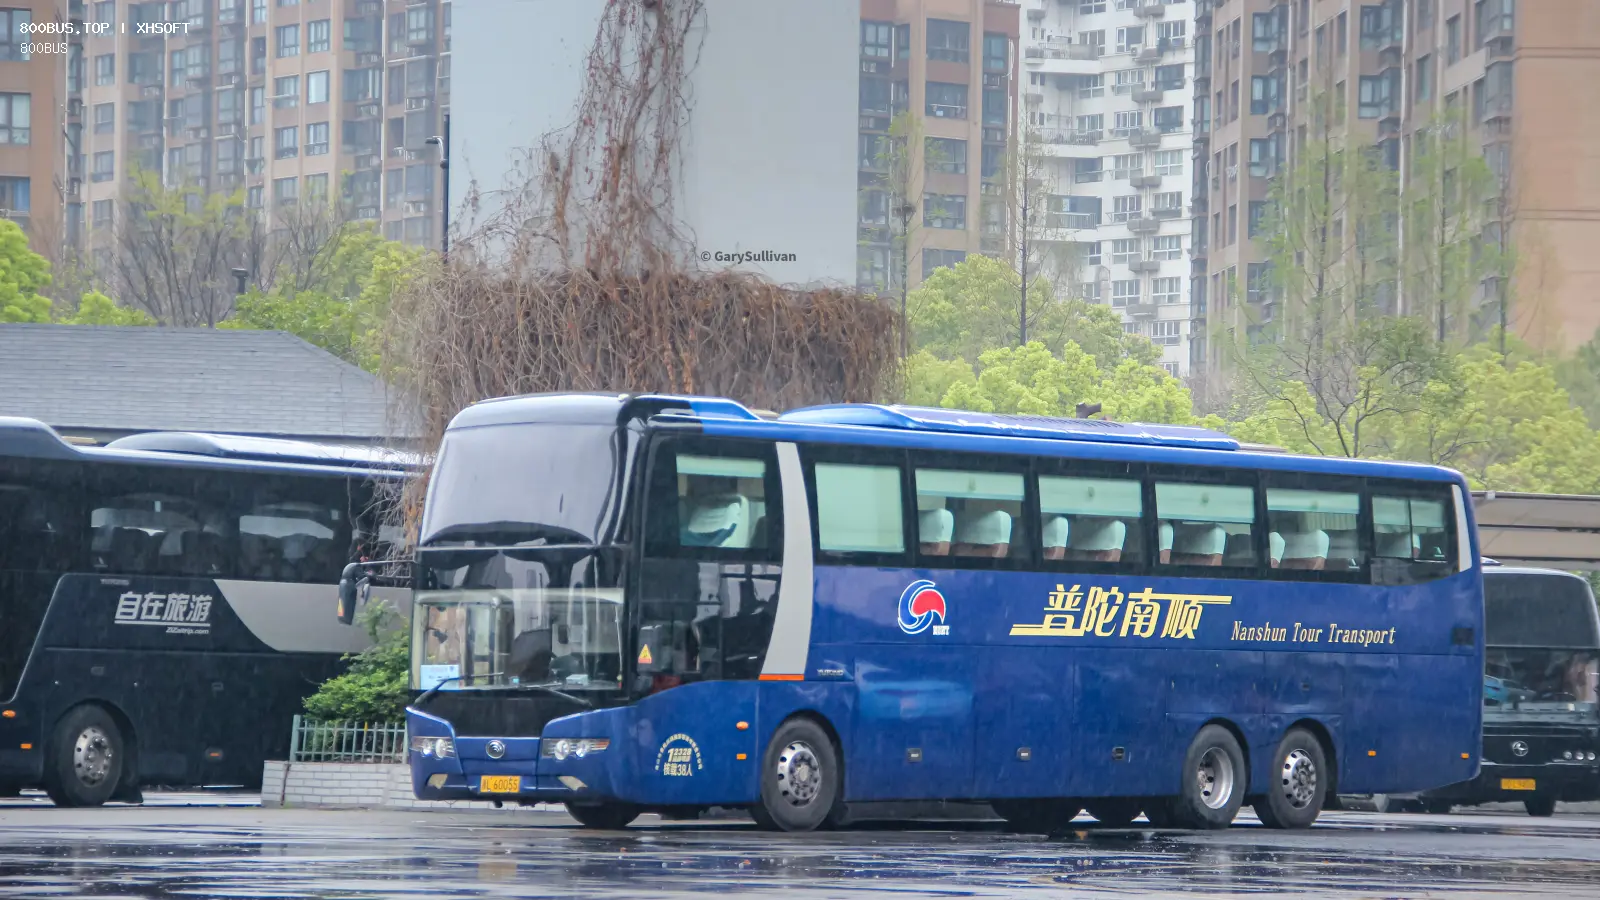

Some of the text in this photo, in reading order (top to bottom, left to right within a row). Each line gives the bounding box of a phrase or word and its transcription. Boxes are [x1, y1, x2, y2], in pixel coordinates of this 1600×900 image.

[114, 591, 213, 622] 自在旅游
[1009, 583, 1233, 640] 普陀南顺
[1231, 620, 1396, 648] Nanshun Tour Transport
